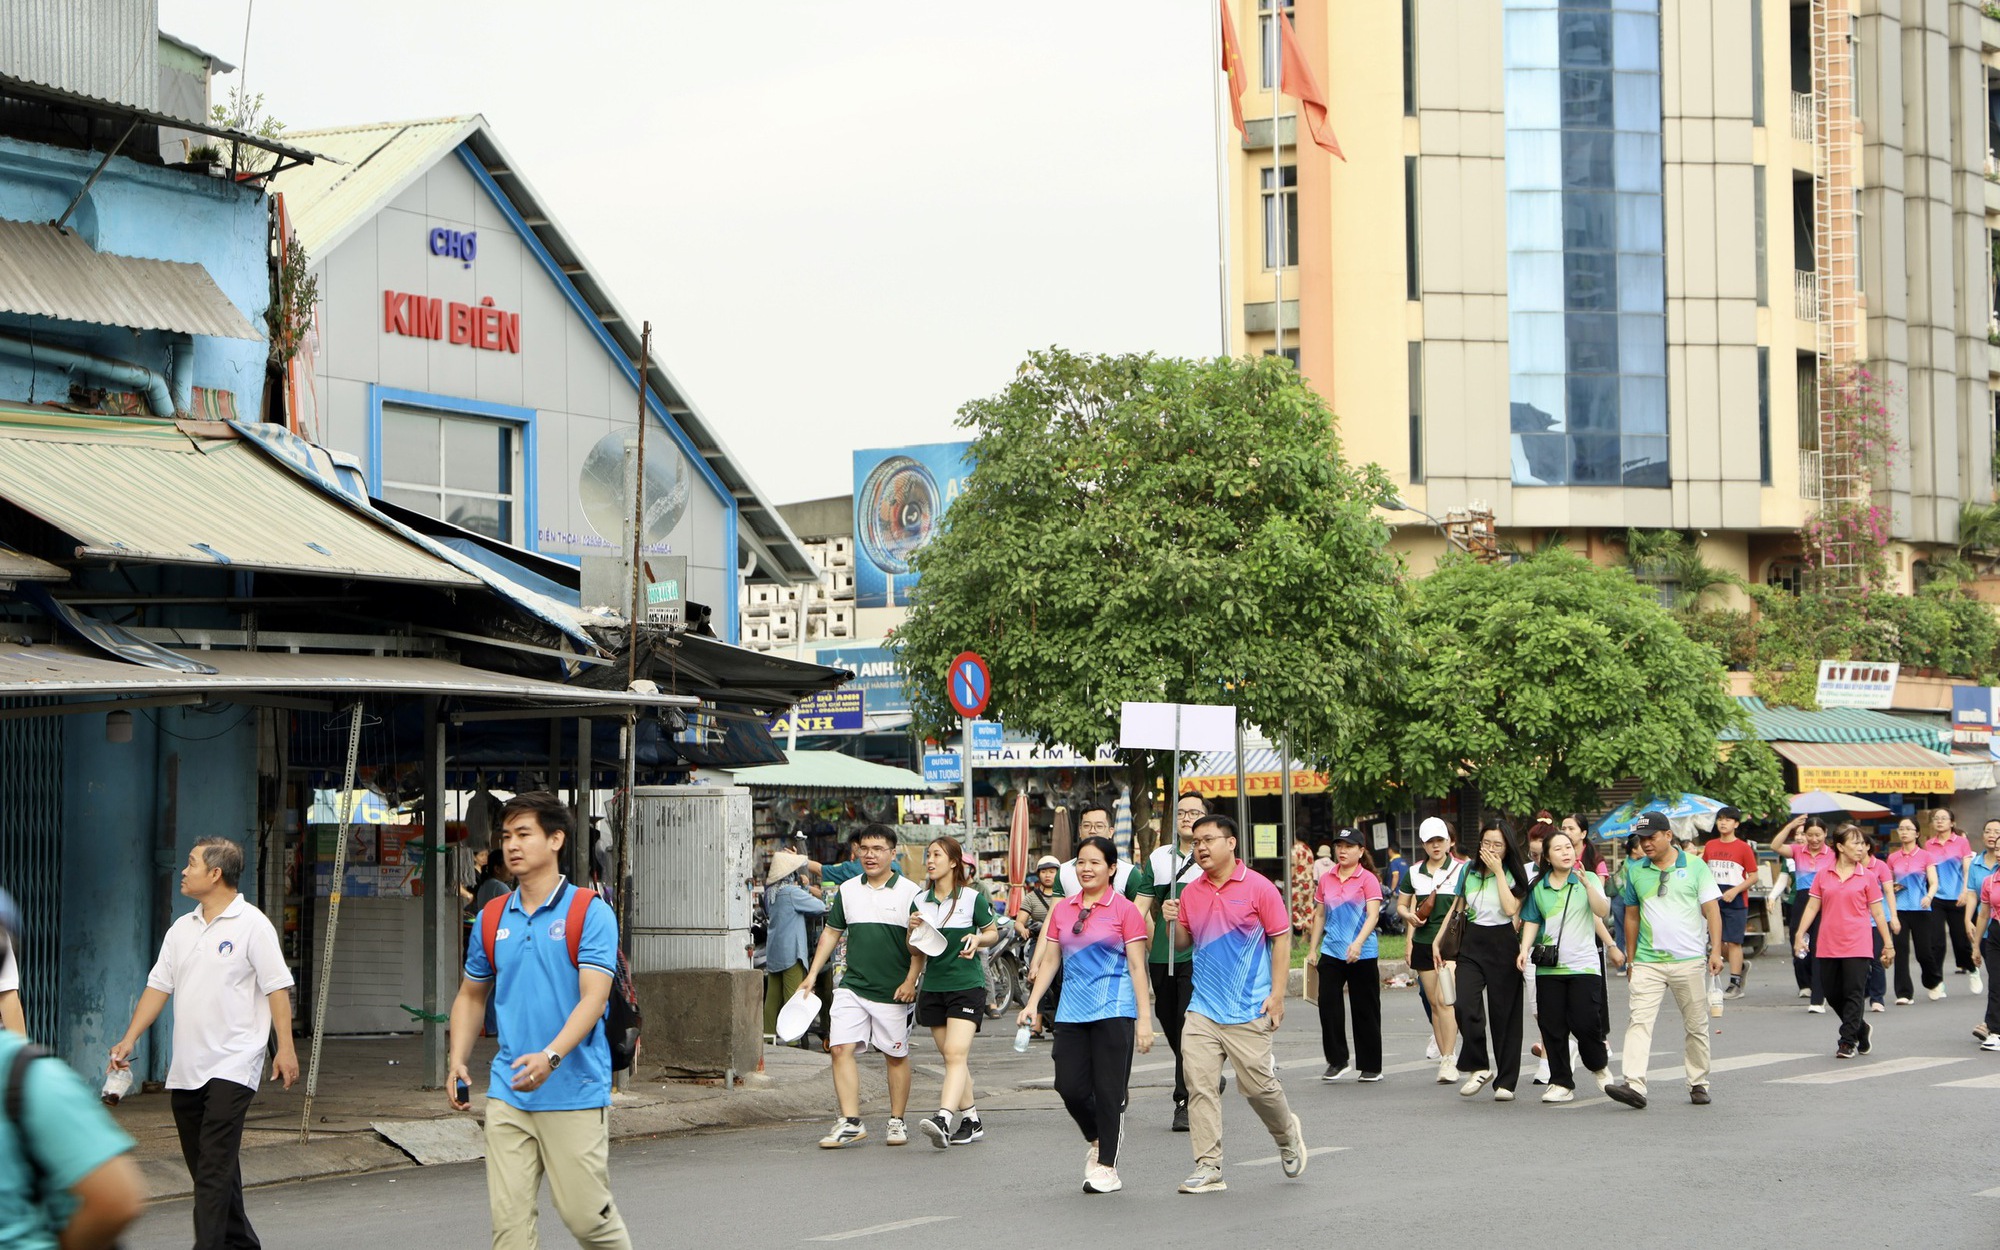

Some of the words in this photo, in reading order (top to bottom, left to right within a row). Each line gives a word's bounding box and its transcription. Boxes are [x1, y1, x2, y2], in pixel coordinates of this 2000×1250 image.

[430, 227, 477, 269] CHỢ
[384, 290, 442, 340] KIM
[449, 296, 520, 354] BIÊN
